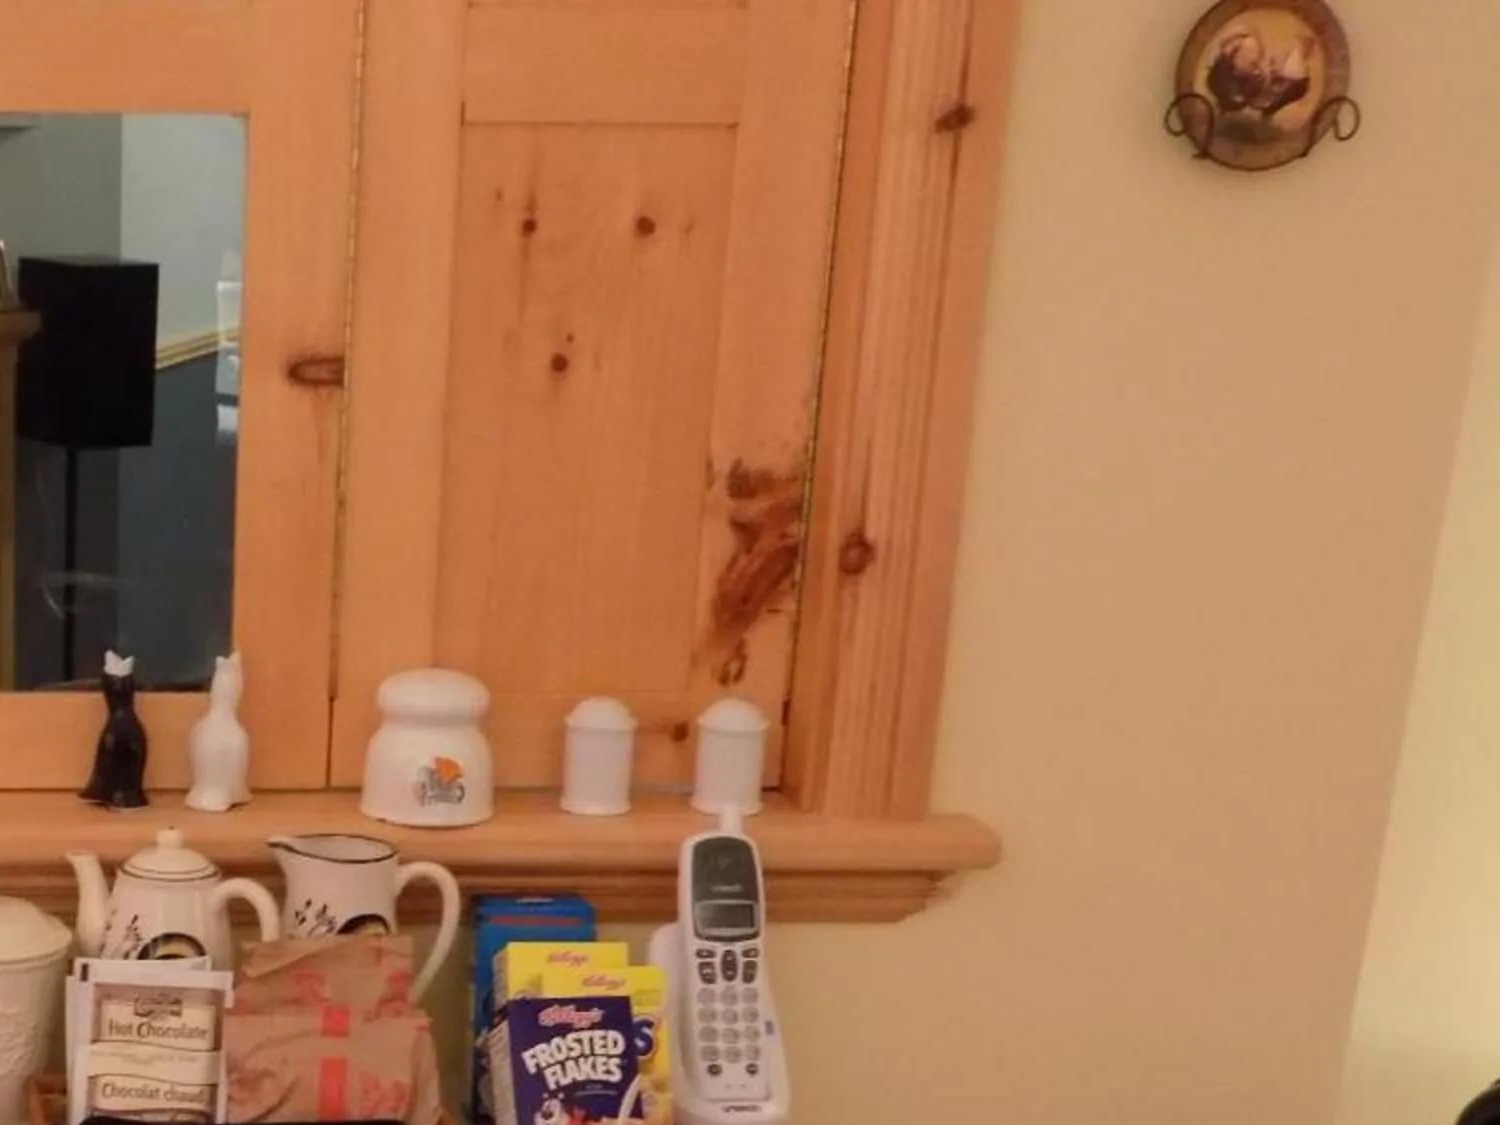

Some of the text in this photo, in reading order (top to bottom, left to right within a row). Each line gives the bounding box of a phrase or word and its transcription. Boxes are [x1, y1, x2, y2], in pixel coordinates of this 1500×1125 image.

[108, 1018, 208, 1040] Hot Chocolate
[521, 1029, 626, 1074] FROSTED
[543, 1056, 623, 1091] FLAKES
[101, 1082, 206, 1102] Chocolat chaud
